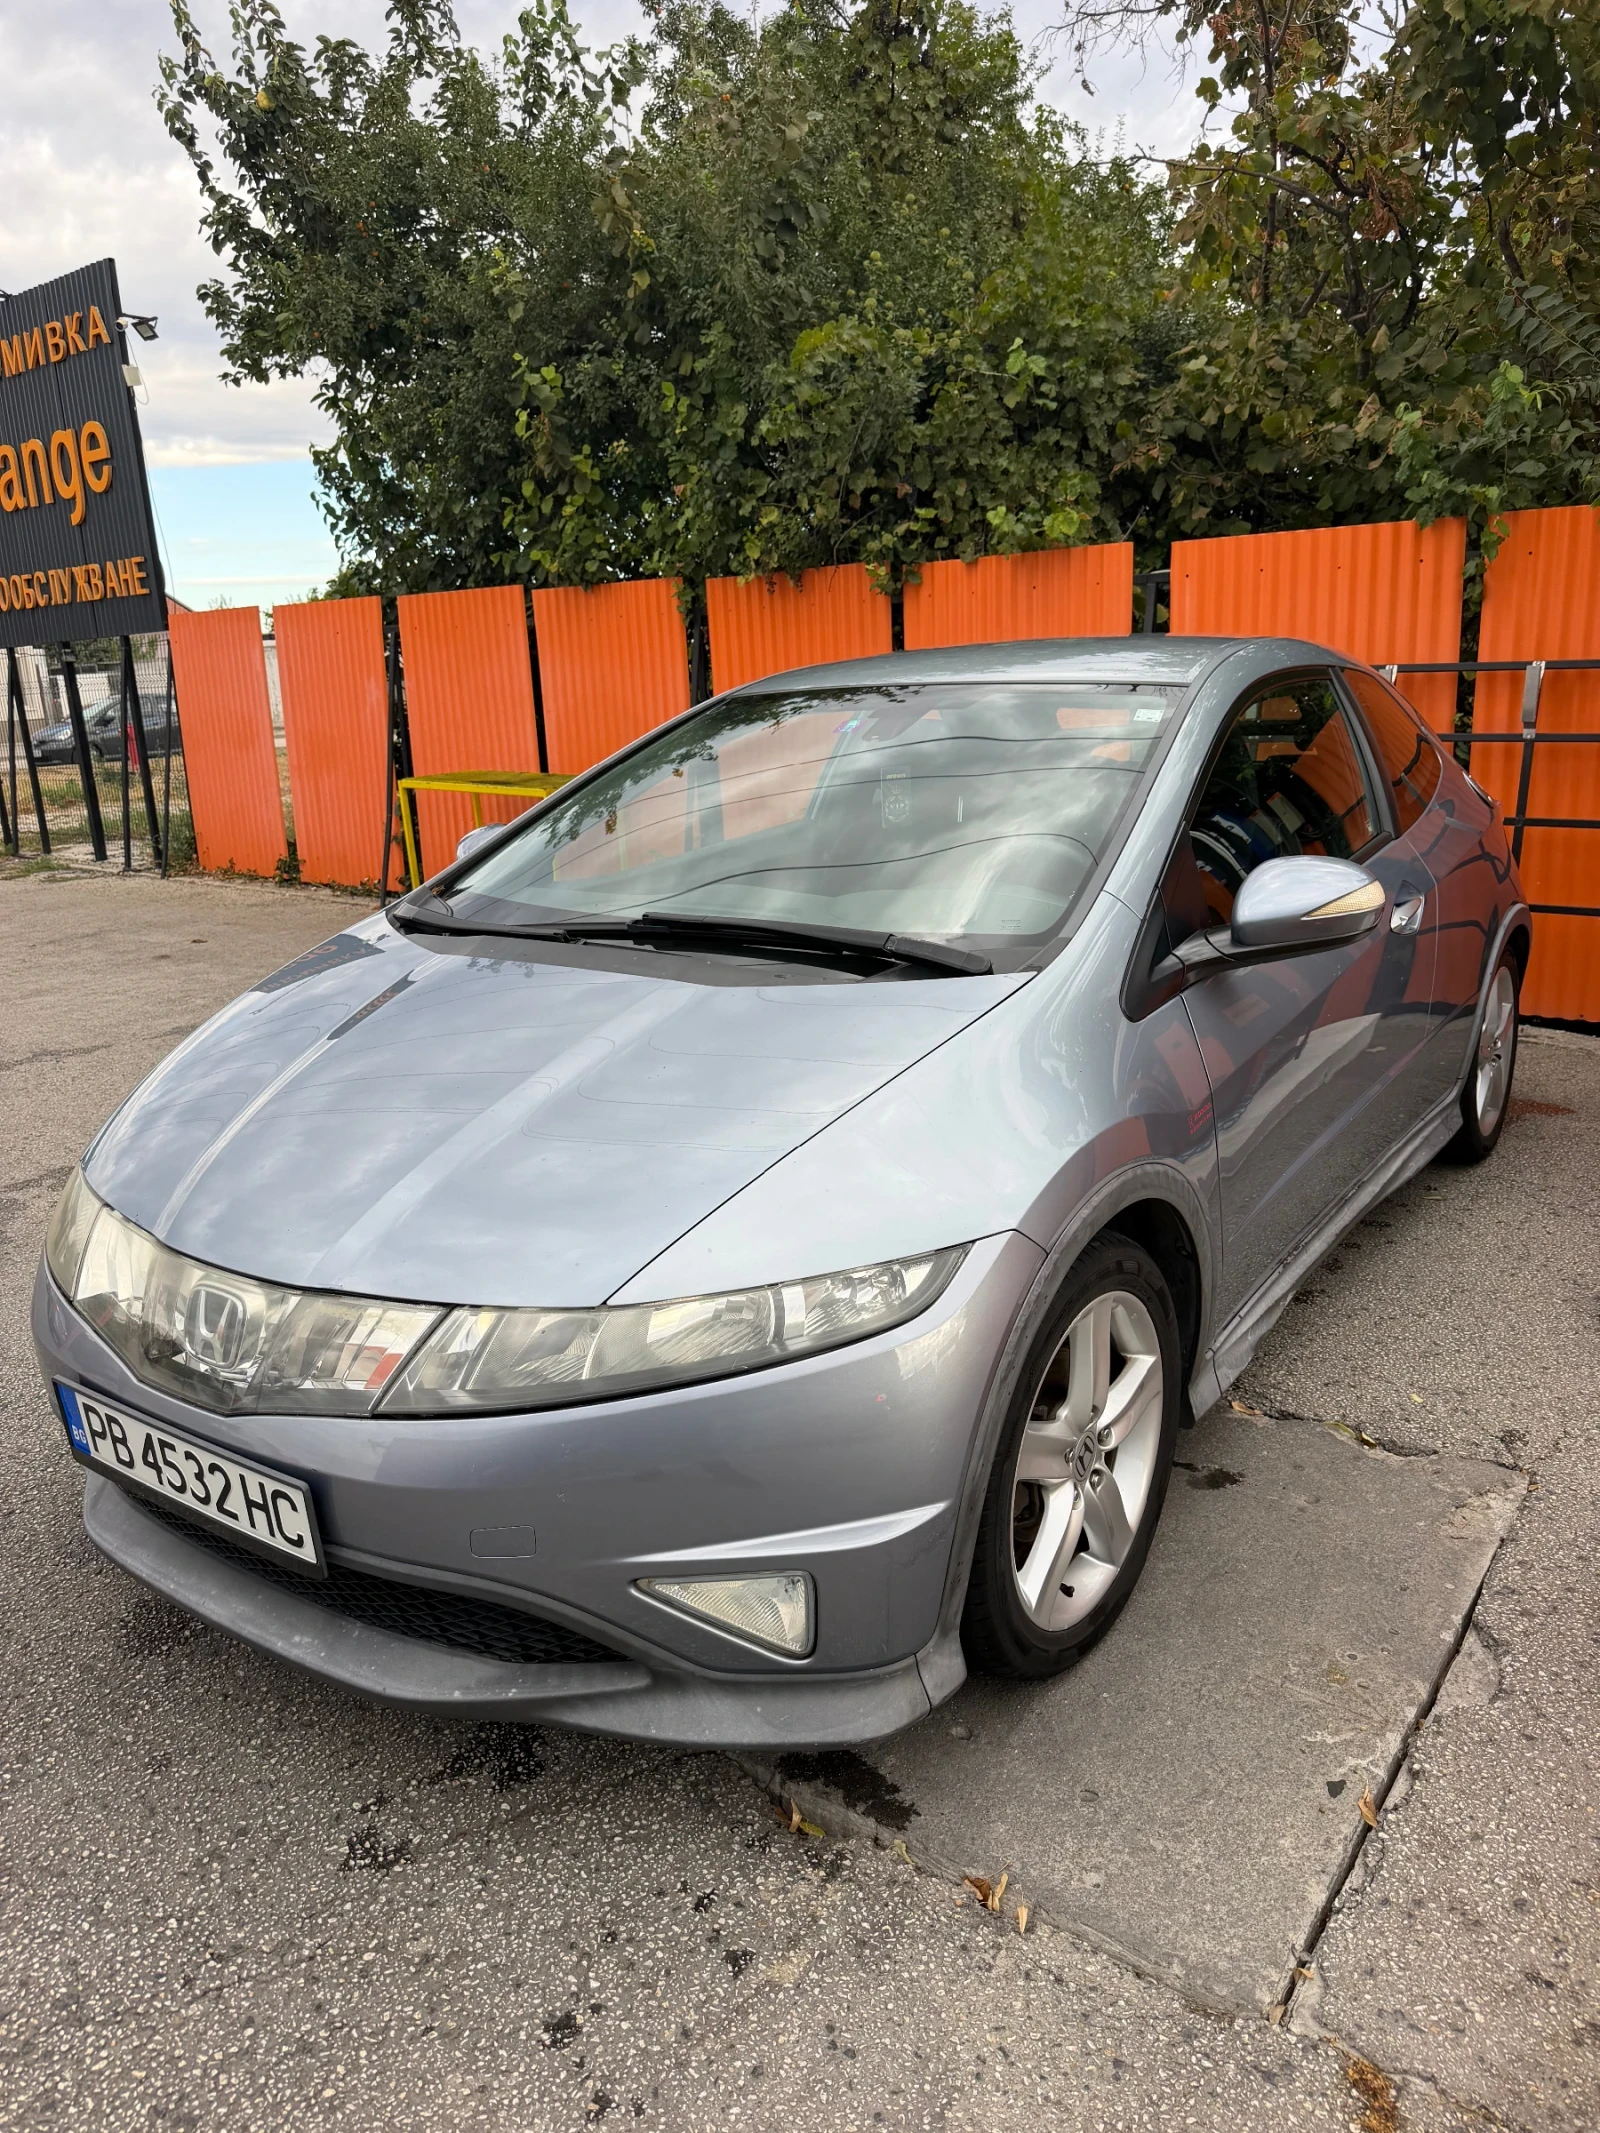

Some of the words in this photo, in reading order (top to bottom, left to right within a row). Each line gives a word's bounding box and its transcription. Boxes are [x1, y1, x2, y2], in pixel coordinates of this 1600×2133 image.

[0, 305, 111, 378] МИВКА
[0, 420, 112, 526] ange
[71, 1424, 87, 1445] BG
[82, 1401, 135, 1470] PB
[141, 1432, 239, 1521] 4532
[238, 1473, 305, 1549] HC
